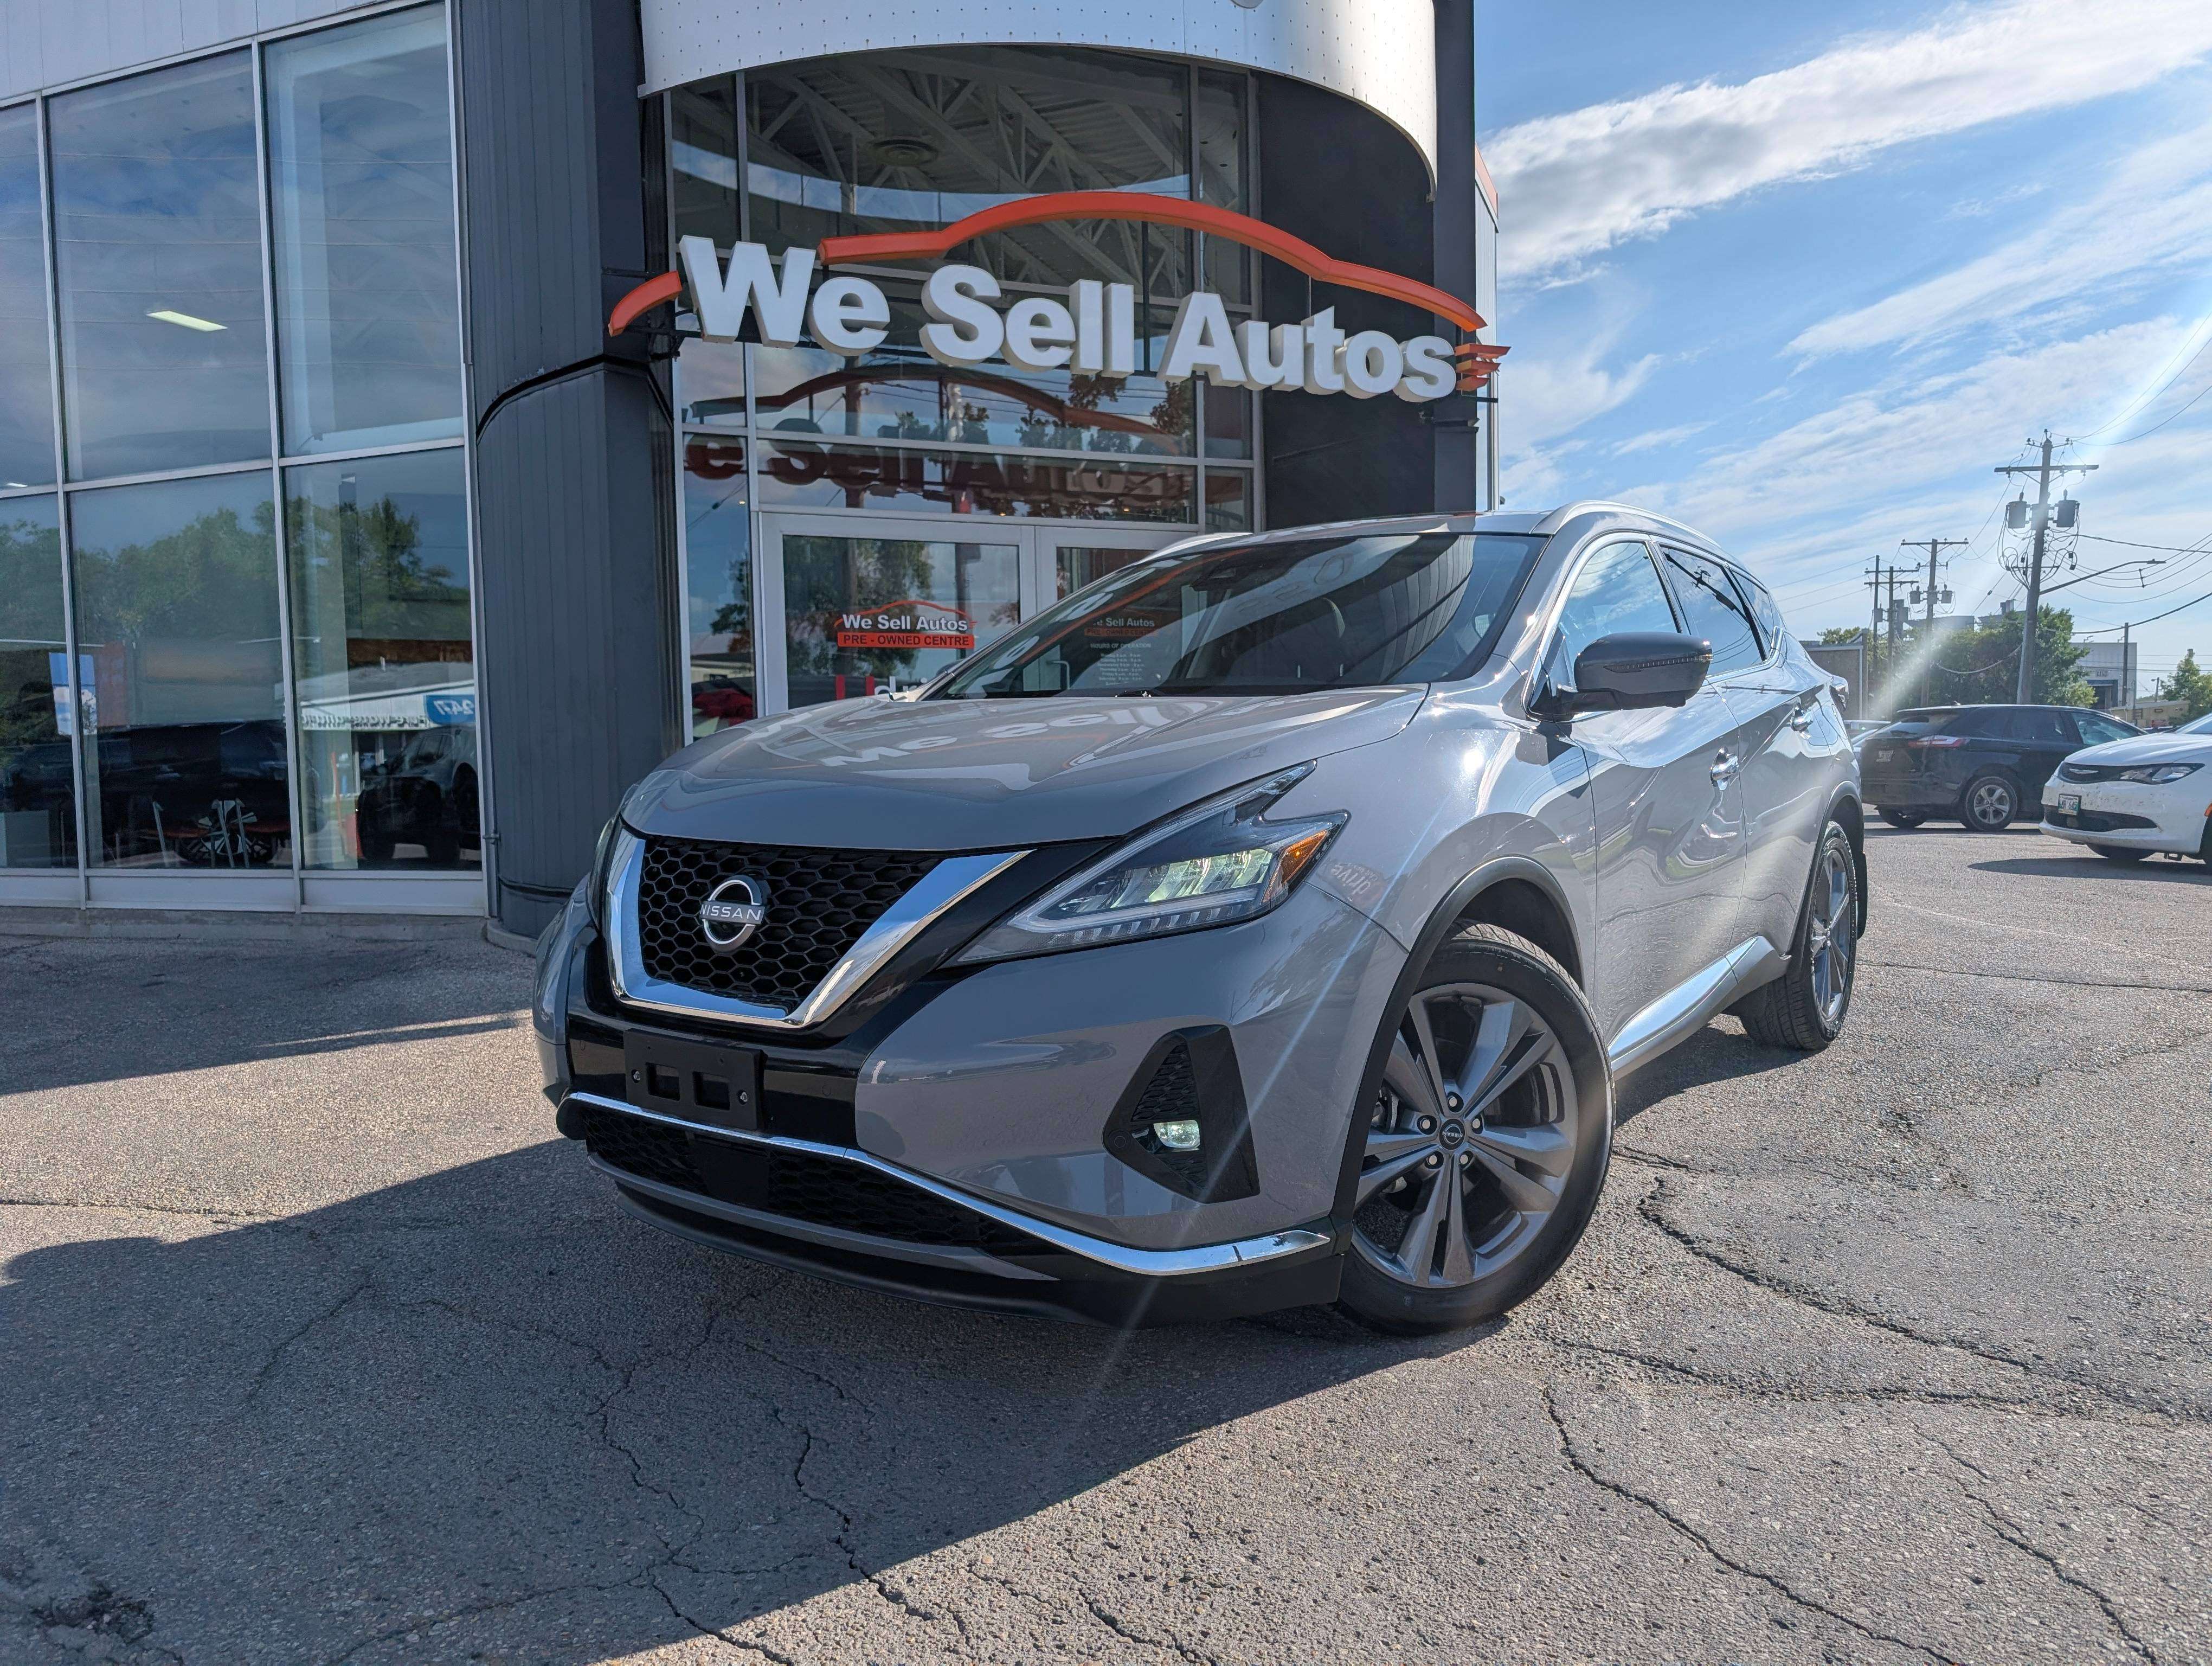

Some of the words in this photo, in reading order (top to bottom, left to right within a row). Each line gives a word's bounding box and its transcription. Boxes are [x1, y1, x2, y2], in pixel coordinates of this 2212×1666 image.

[679, 235, 890, 356] We
[919, 265, 1134, 378] Sell
[1156, 292, 1456, 402] Autos
[843, 614, 872, 629] We
[878, 614, 911, 630] Sell
[916, 616, 968, 631] Autos
[1106, 618, 1124, 627] Sell
[1127, 618, 1155, 627] Autos
[844, 635, 867, 645] PRE
[878, 635, 921, 645] OWNED
[924, 636, 969, 646] CENTRE
[699, 904, 762, 920] NISSAN
